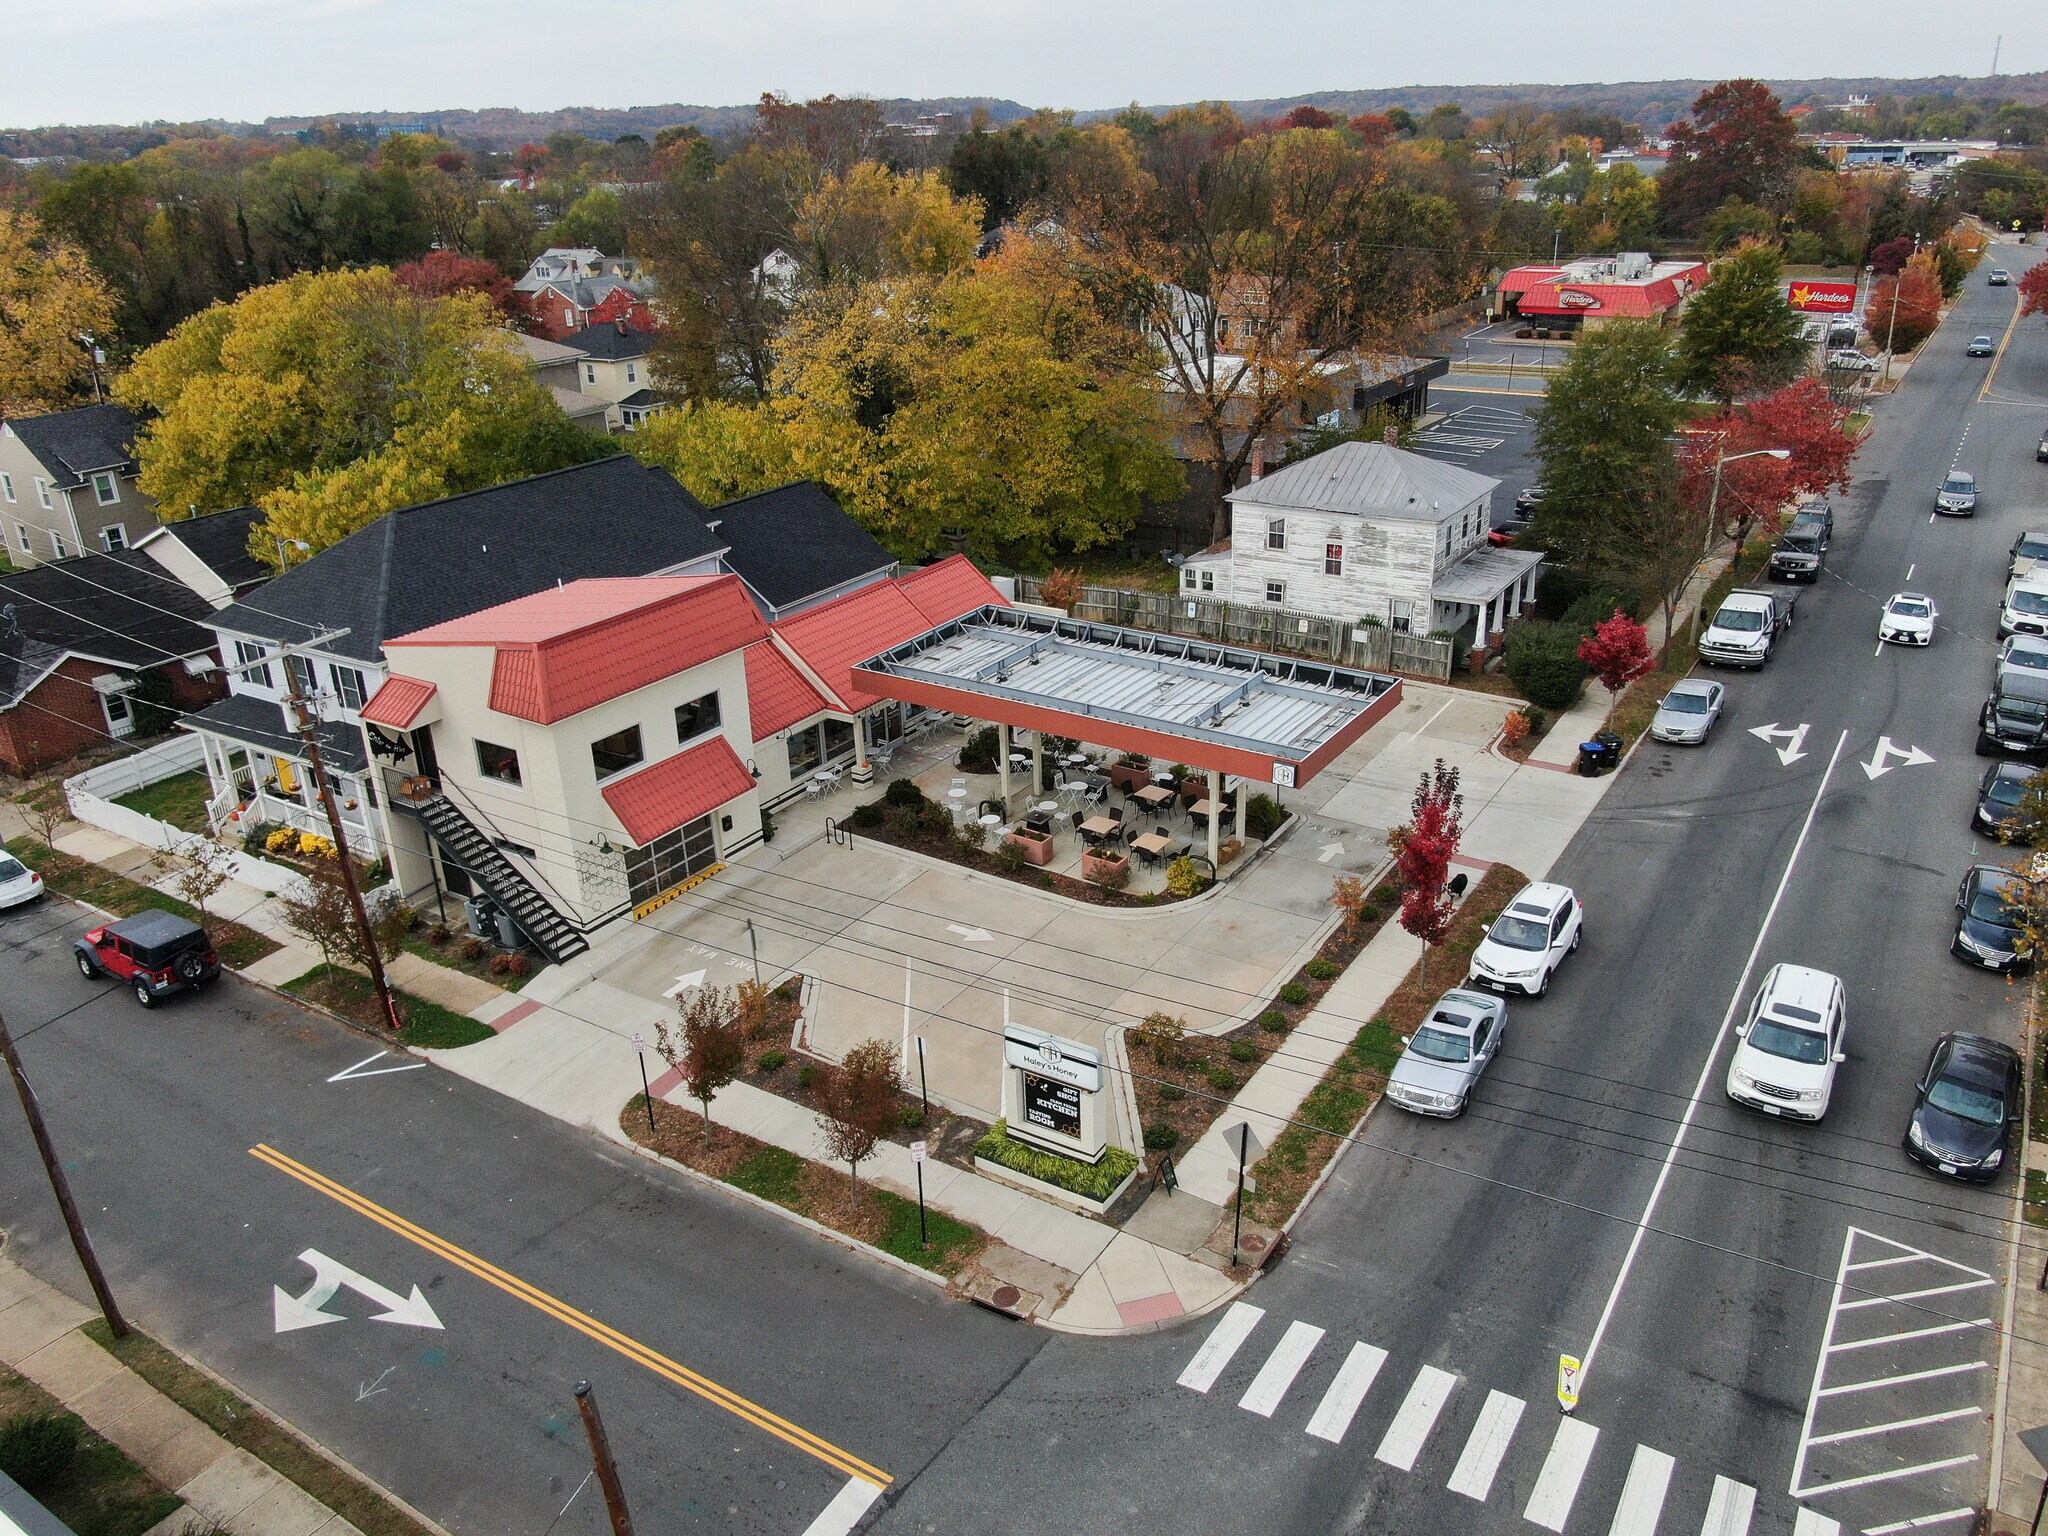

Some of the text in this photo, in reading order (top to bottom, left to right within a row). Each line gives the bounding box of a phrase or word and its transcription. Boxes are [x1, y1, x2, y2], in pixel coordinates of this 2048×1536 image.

[1805, 291, 1851, 302] Hardee's
[1023, 1055, 1052, 1070] Haley's
[1053, 1065, 1078, 1079] Honey
[1056, 1091, 1079, 1103] SHOP
[1062, 1087, 1079, 1096] GIFT
[1028, 1108, 1052, 1120] TASTING
[1036, 1098, 1078, 1118] KITCHEN
[1029, 1114, 1055, 1128] ROOM
